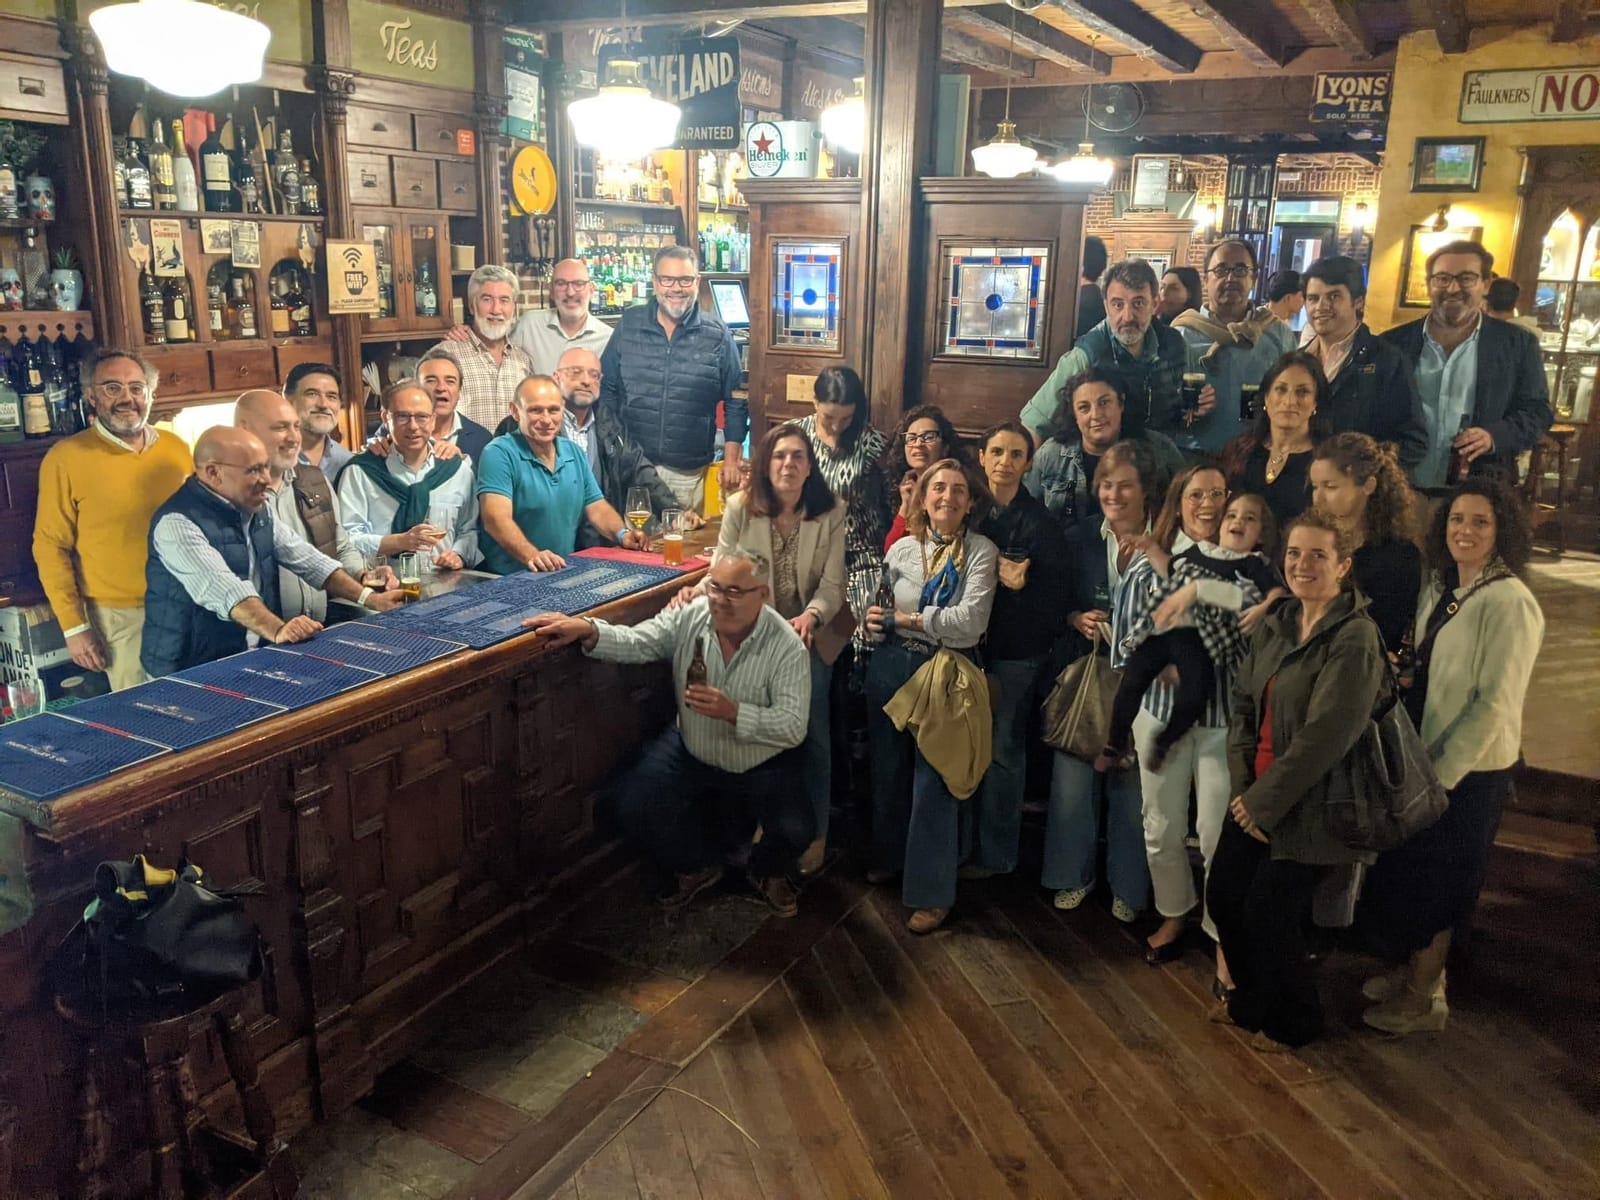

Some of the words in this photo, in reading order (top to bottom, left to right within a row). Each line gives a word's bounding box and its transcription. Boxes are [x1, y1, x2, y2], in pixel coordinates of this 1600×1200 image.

[380, 16, 438, 69] Teas
[1345, 97, 1384, 112] TEA
[678, 126, 734, 140] ARANTEED
